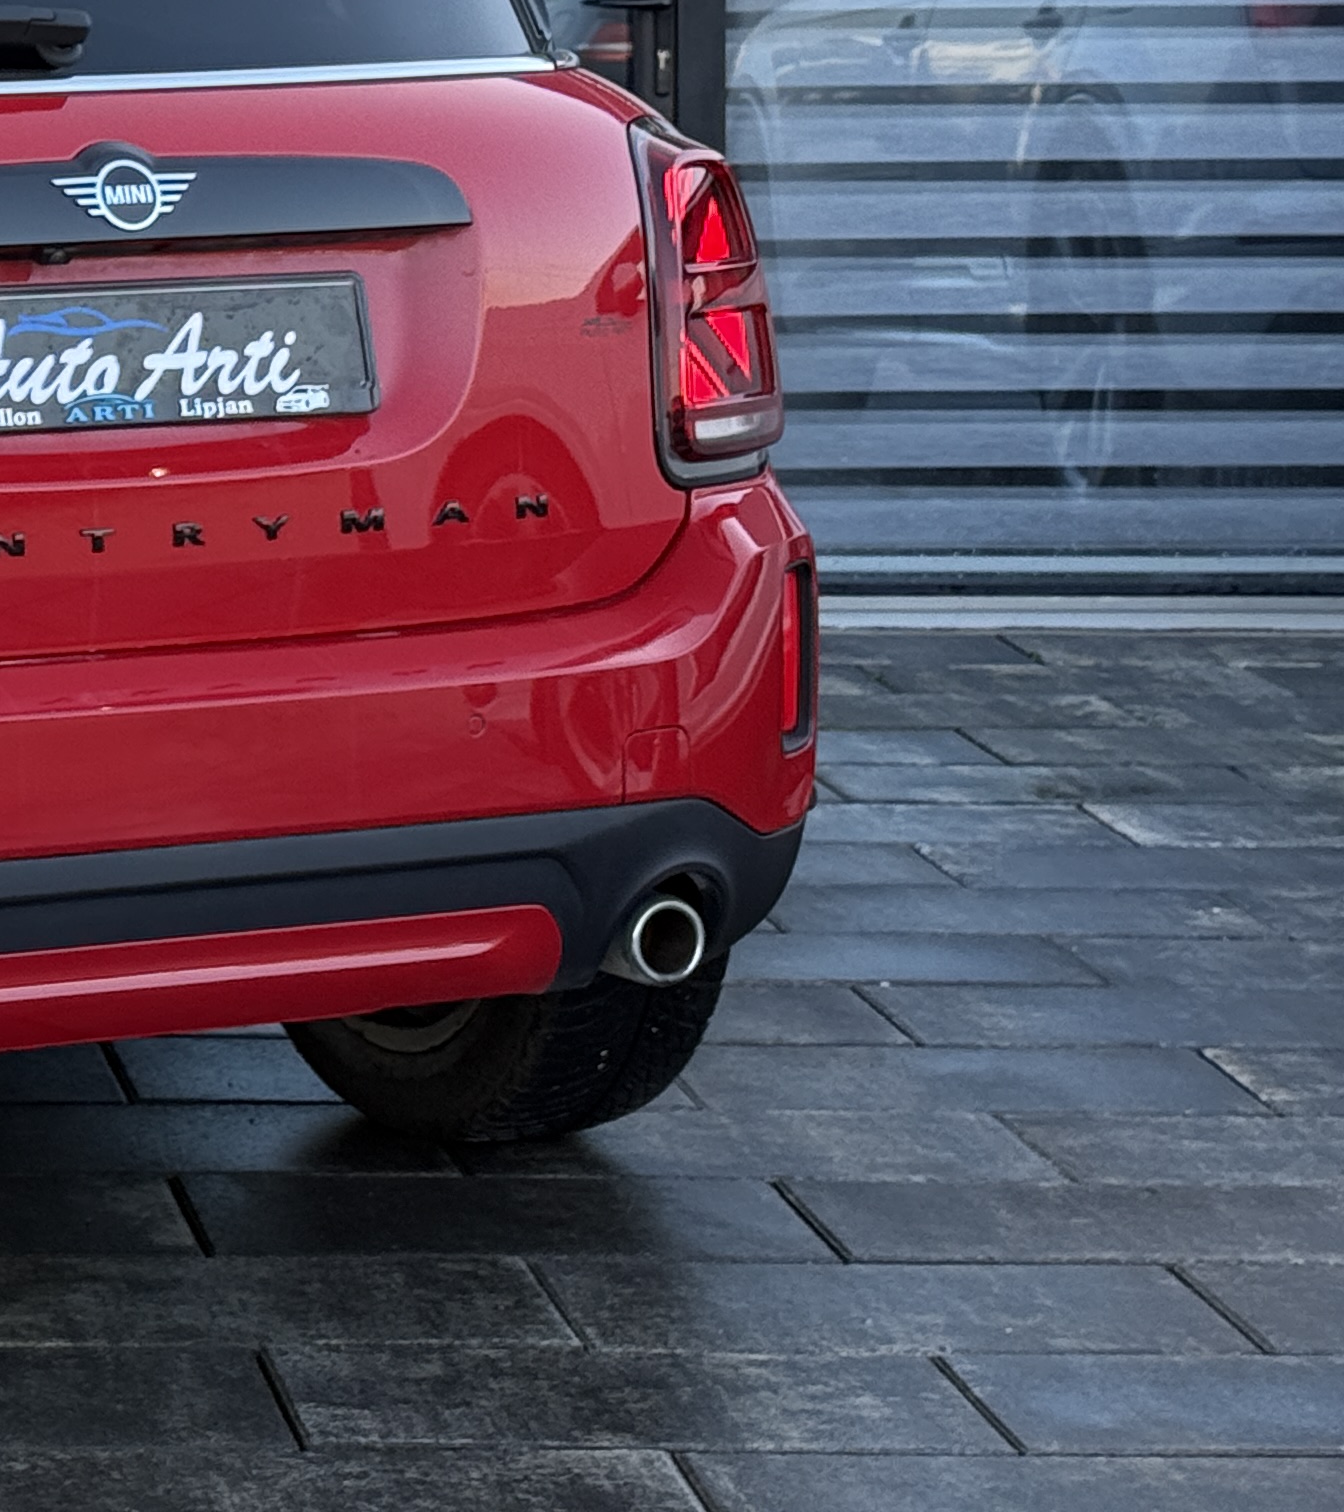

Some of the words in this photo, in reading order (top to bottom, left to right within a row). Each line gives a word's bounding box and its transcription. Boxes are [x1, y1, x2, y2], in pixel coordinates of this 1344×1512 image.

[103, 183, 154, 205] MINI
[134, 311, 301, 401] Arti
[66, 399, 155, 424] ARTI
[178, 396, 254, 419] Lipjan
